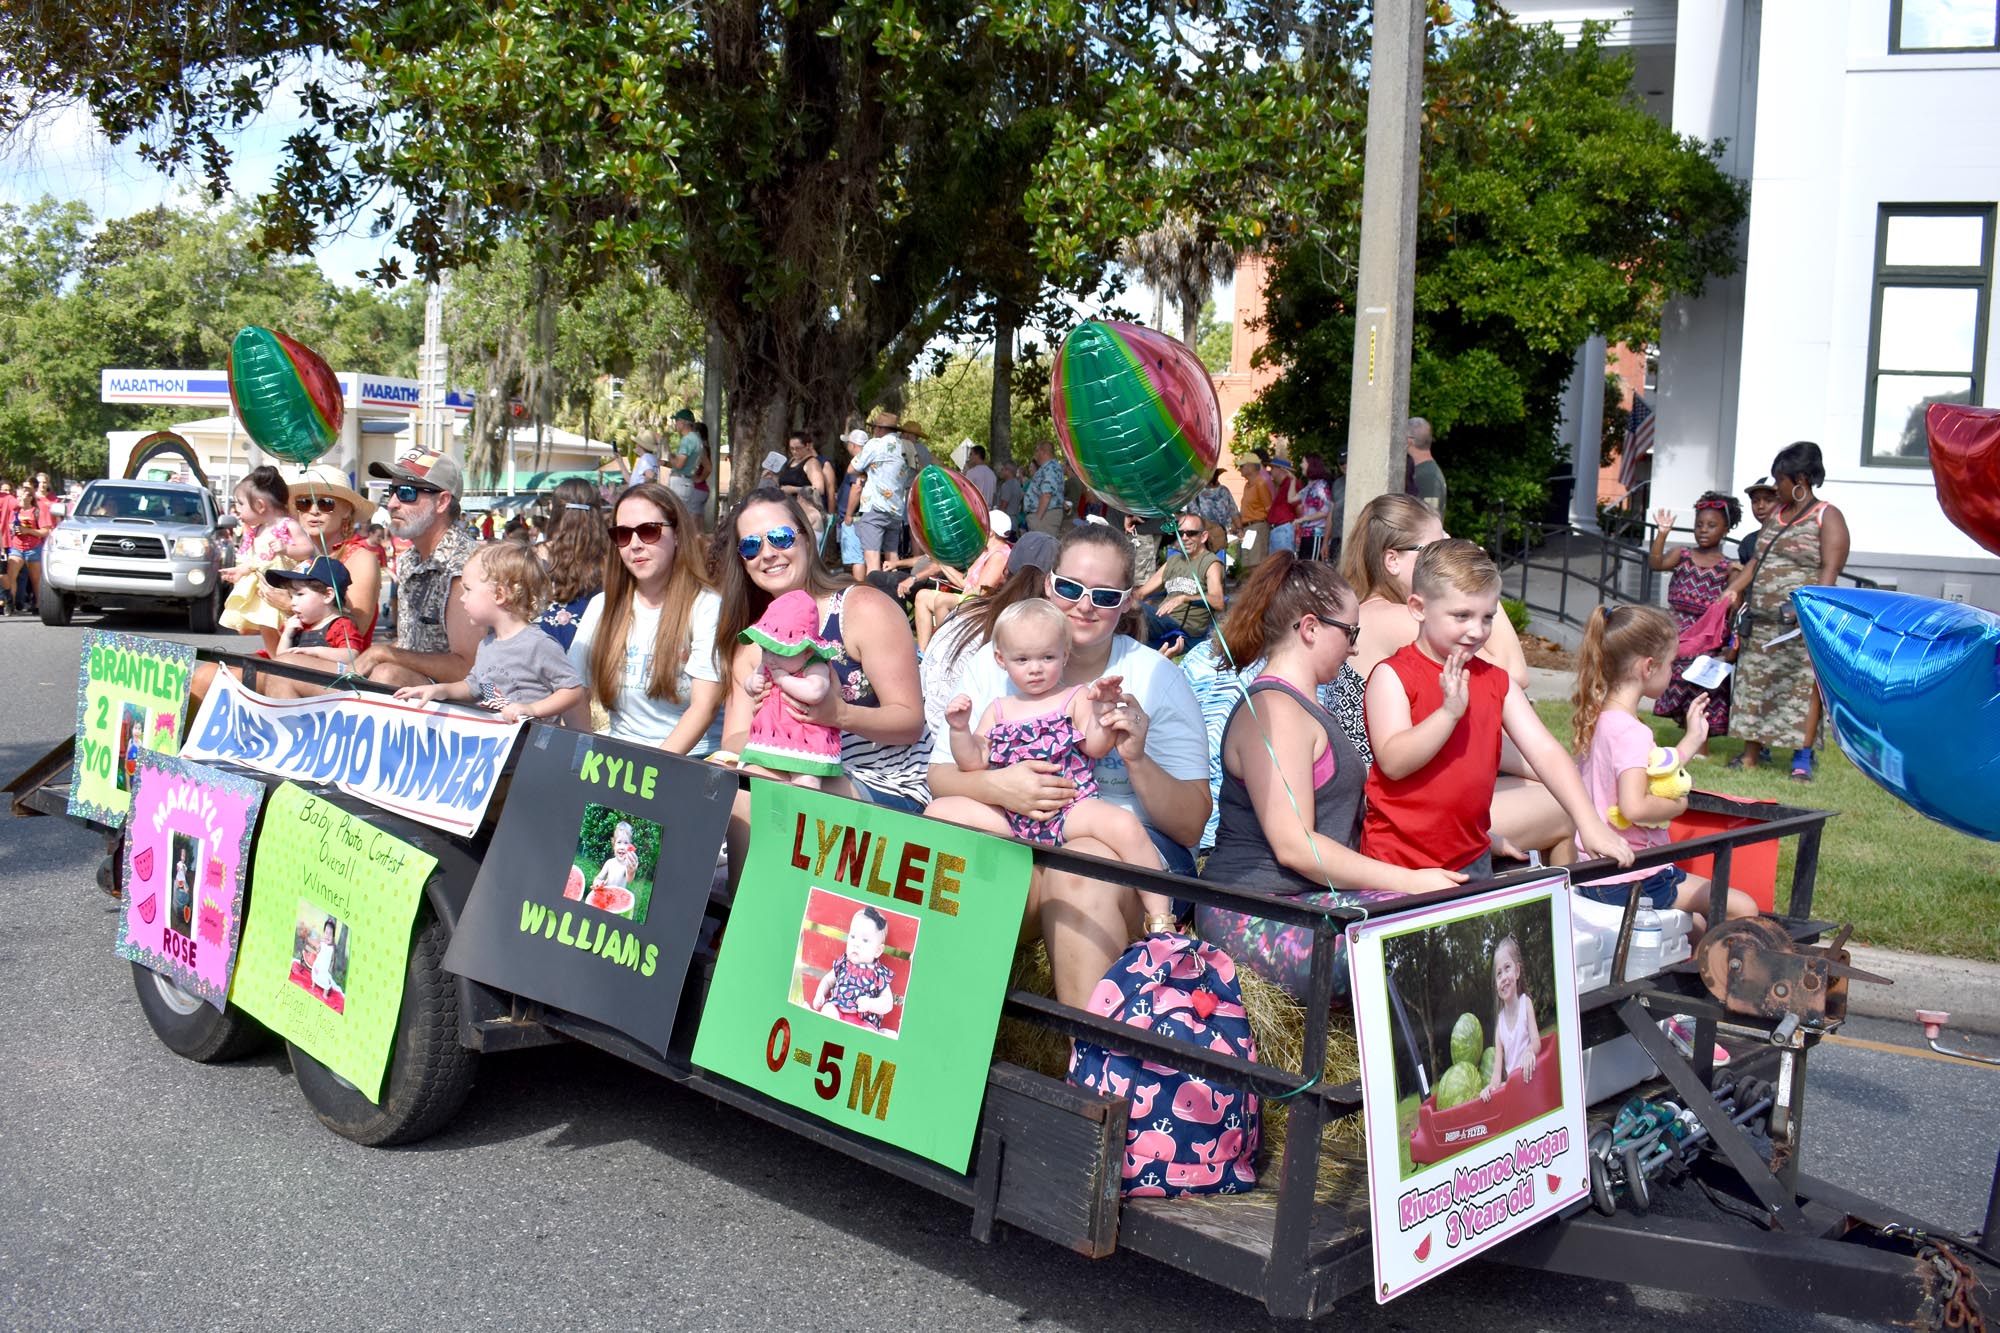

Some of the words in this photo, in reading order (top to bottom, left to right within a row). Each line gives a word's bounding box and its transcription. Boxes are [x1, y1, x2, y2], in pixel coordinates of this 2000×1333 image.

[110, 379, 184, 392] MARATHON
[362, 383, 420, 401] MARATH
[91, 646, 187, 702] BRANTLEY
[97, 696, 110, 730] 2
[83, 737, 112, 779] Y/O
[196, 688, 279, 761] BABY
[276, 710, 376, 786] PHOTO
[374, 718, 511, 812] WINNERS
[580, 750, 659, 800] KYLE
[153, 784, 224, 853] MAKAYLA
[299, 798, 334, 843] Baby
[336, 814, 363, 852] Photo
[319, 841, 357, 883] Overall
[791, 812, 966, 917] LYNLEE
[163, 927, 198, 968] ROSE
[520, 900, 659, 978] WILLIAMS
[1399, 1180, 1453, 1232] Rivers
[1453, 1153, 1515, 1205] Monroe
[1514, 1127, 1570, 1175] Morgan
[1446, 1210, 1461, 1248] 3
[1460, 1193, 1509, 1240] Years
